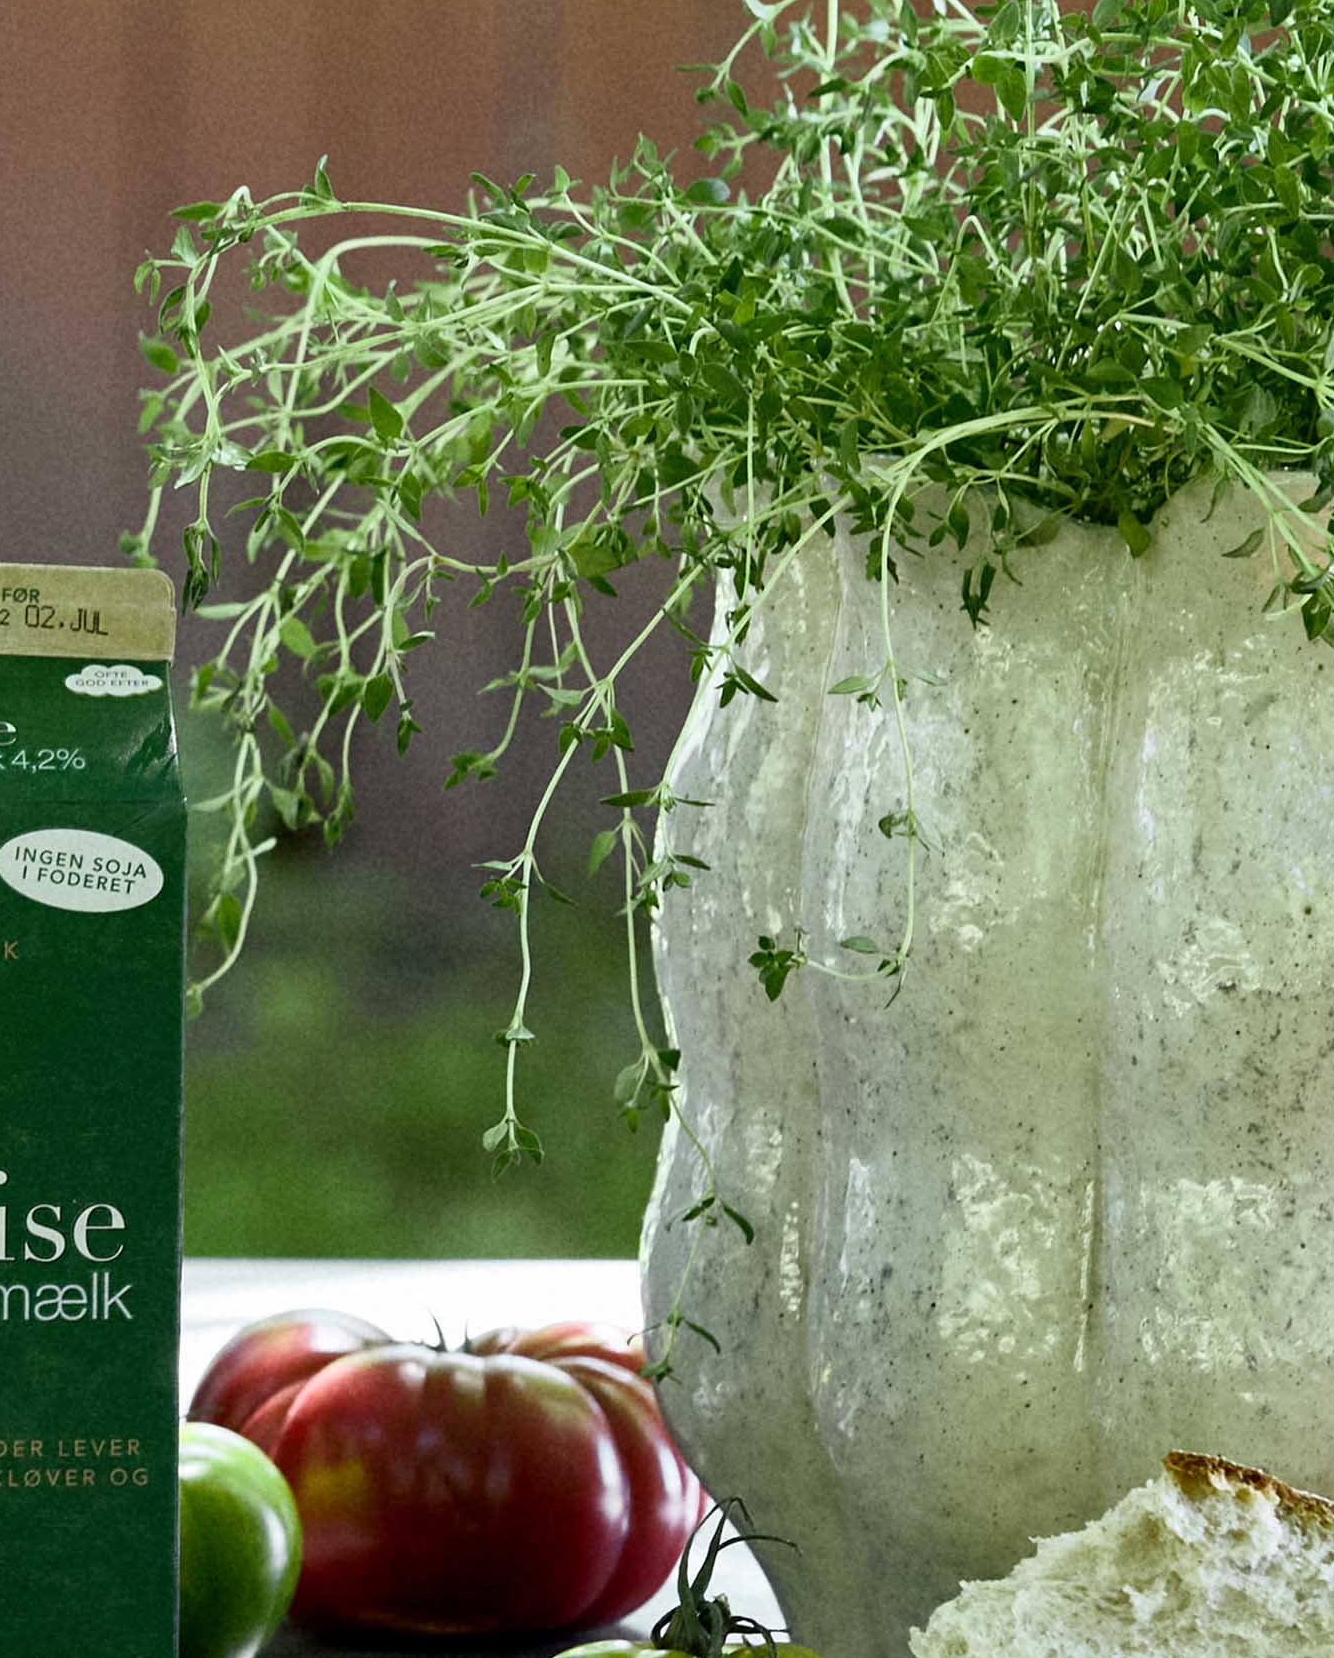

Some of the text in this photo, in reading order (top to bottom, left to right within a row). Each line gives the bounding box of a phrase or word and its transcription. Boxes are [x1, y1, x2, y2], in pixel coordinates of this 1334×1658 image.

[2, 587, 41, 604] FØR
[24, 604, 109, 636] 02.JUL
[10, 747, 87, 774] 4,2%
[14, 846, 147, 879] INGEN SOJA
[21, 865, 136, 895] I FODERET
[57, 1438, 142, 1458] LEVER
[108, 1467, 150, 1486] OG
